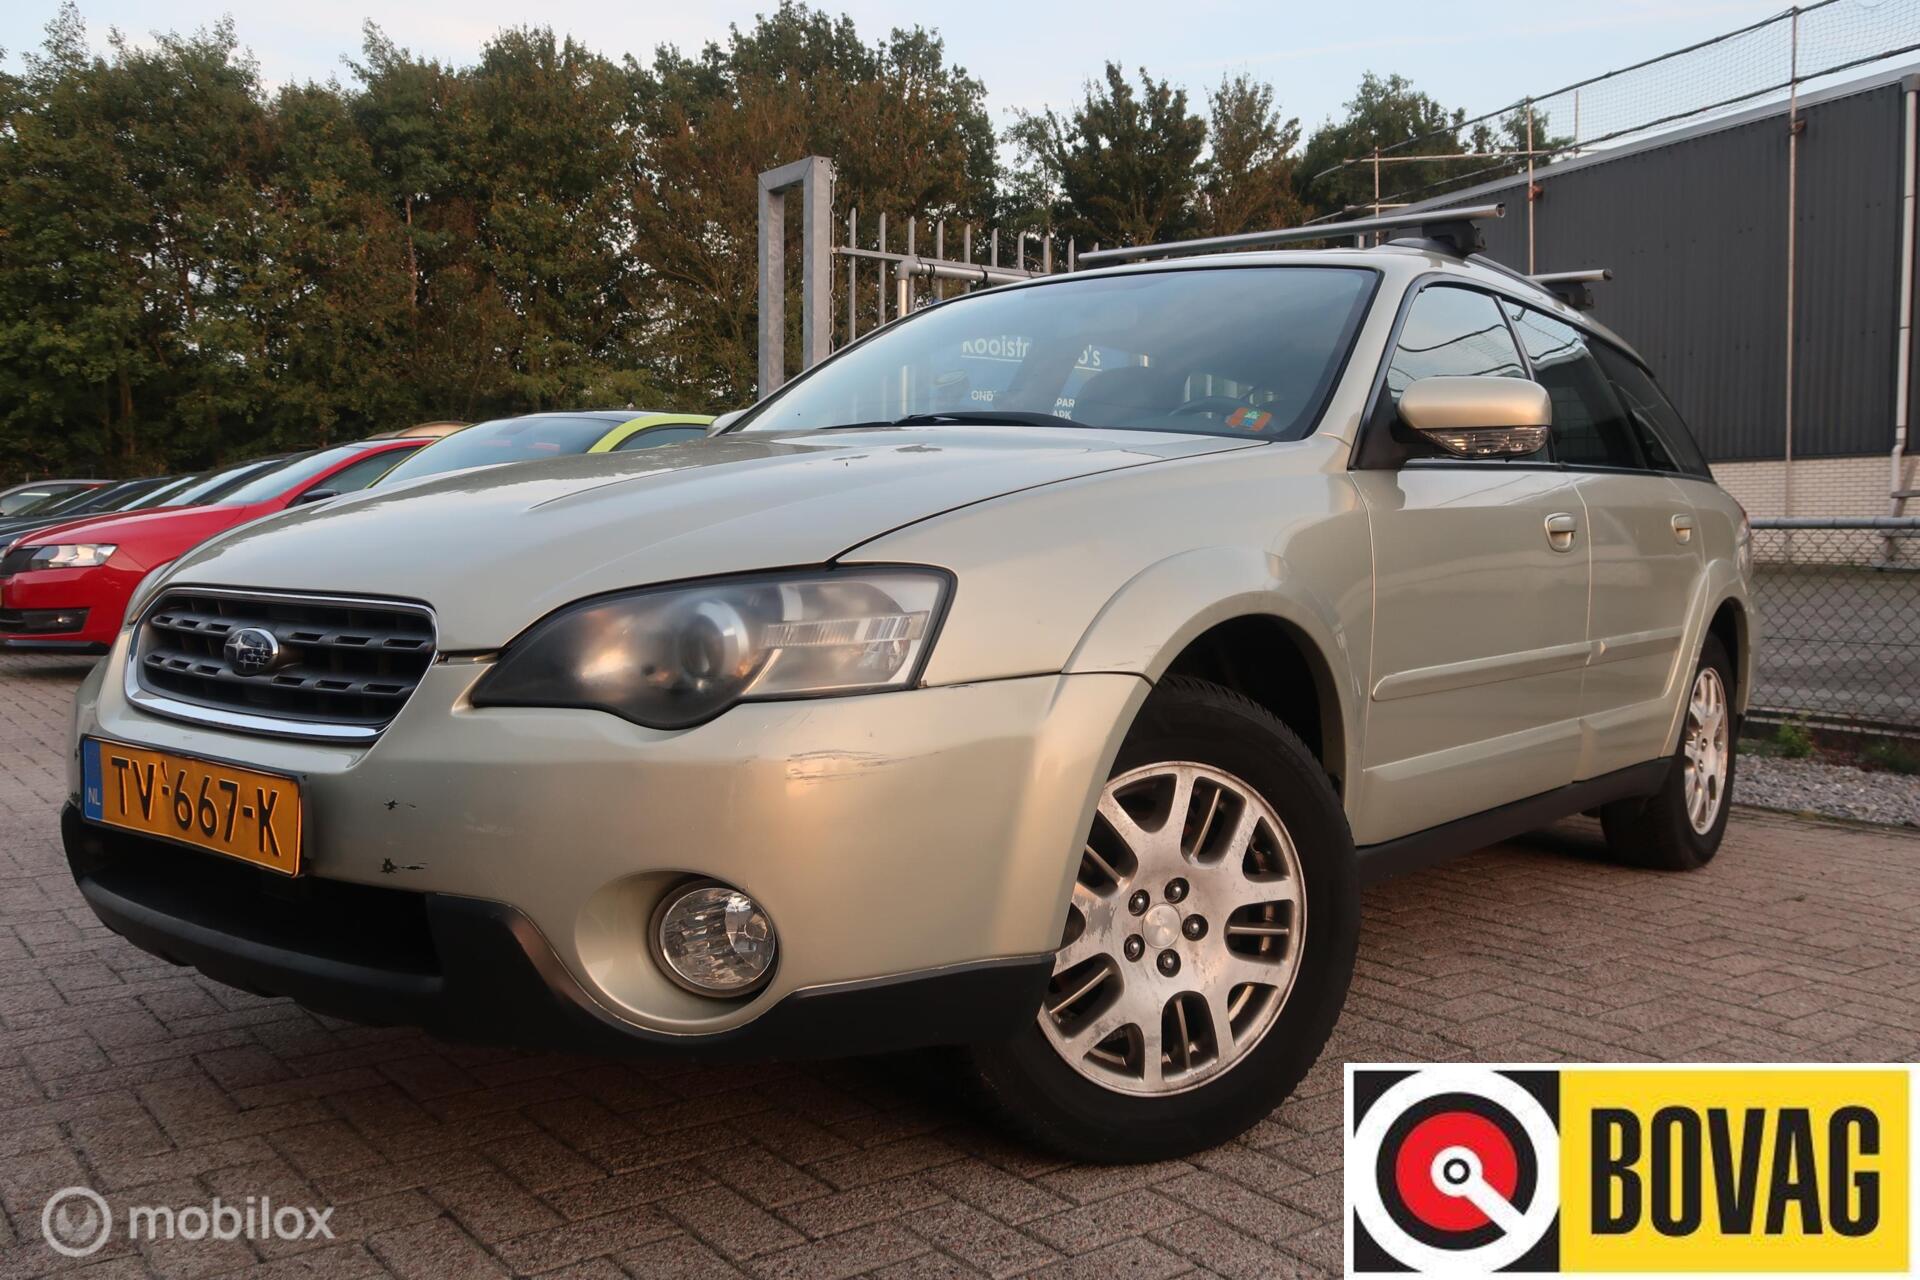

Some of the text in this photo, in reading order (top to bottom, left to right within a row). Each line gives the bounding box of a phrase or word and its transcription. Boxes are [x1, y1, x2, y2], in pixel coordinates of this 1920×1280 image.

[962, 335, 1029, 357] Kooistr
[87, 755, 281, 857] NL TV-667-K
